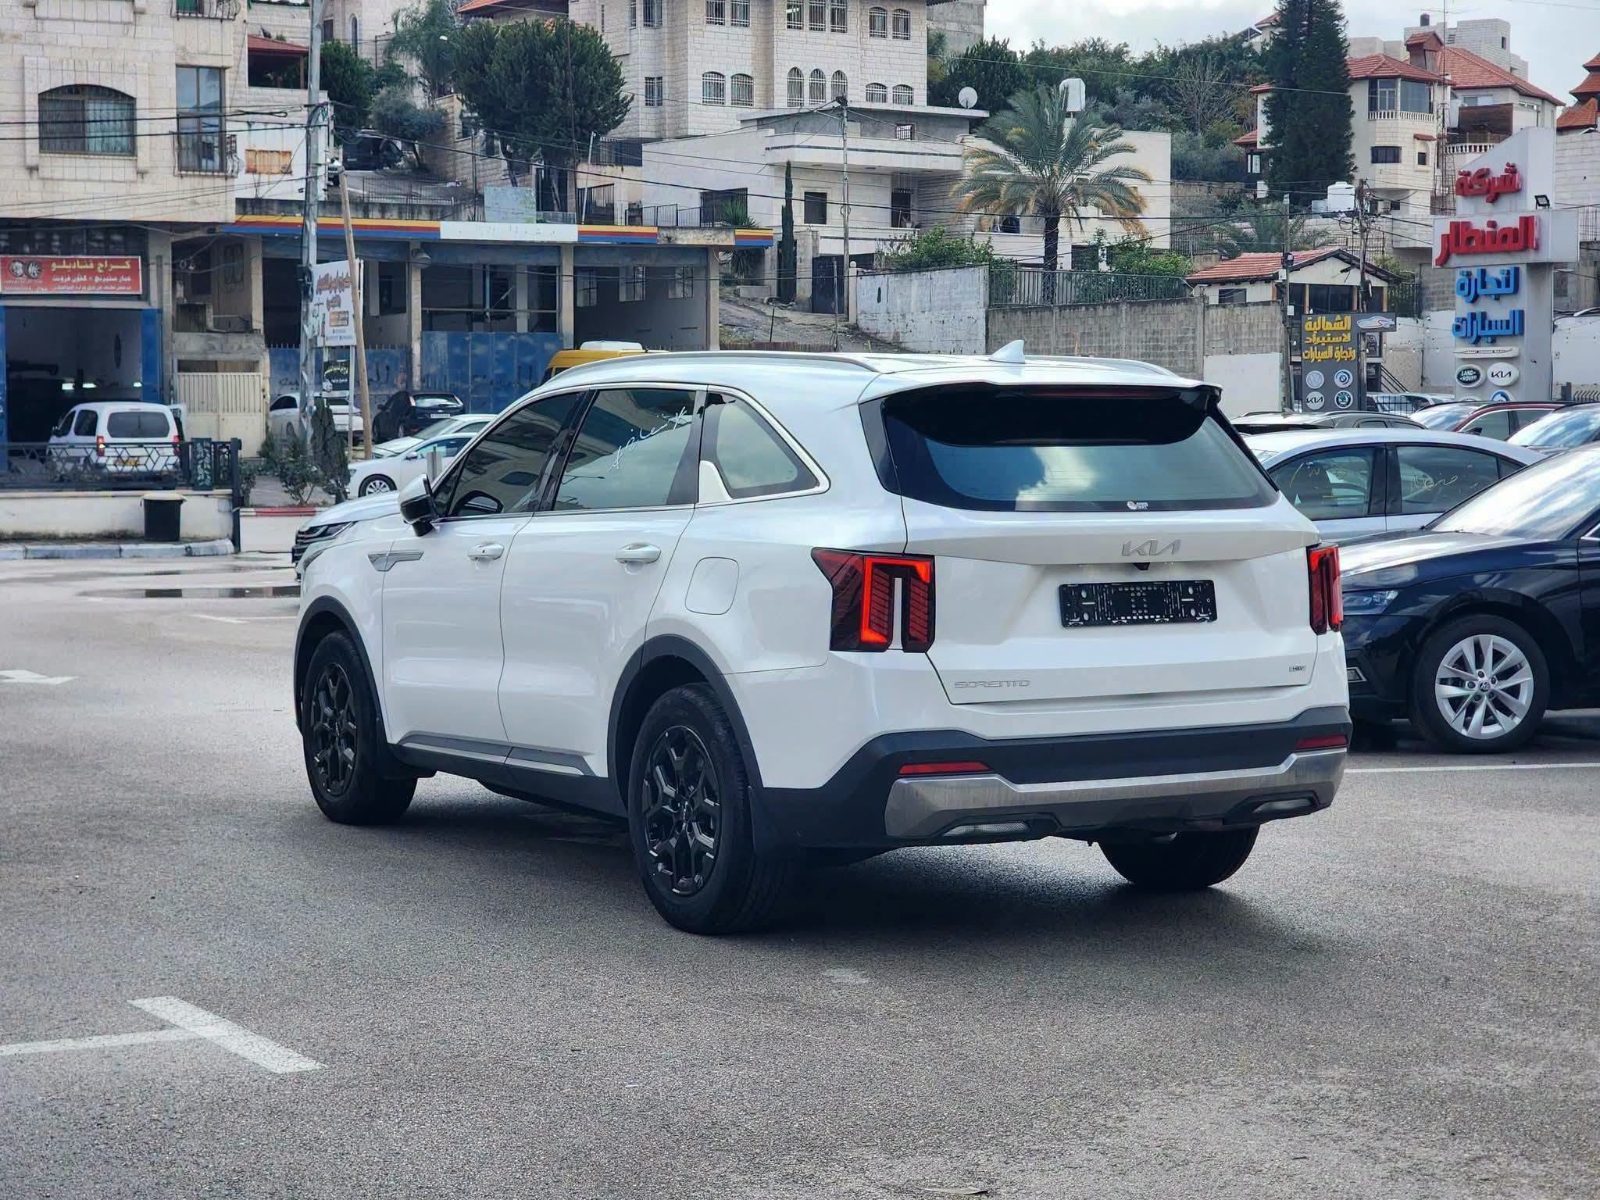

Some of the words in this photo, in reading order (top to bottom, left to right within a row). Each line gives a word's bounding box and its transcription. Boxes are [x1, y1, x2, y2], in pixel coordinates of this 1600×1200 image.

[1456, 162, 1521, 203] شركة
[1435, 216, 1539, 266] المنطار
[1455, 266, 1520, 304] لتجارة
[1304, 315, 1352, 331] الشمالية
[1451, 308, 1525, 345] السيارات
[1302, 345, 1333, 363] السيارات
[1491, 370, 1512, 378] KIA
[1121, 538, 1182, 557] KIA
[954, 680, 1031, 689] SORENTO
